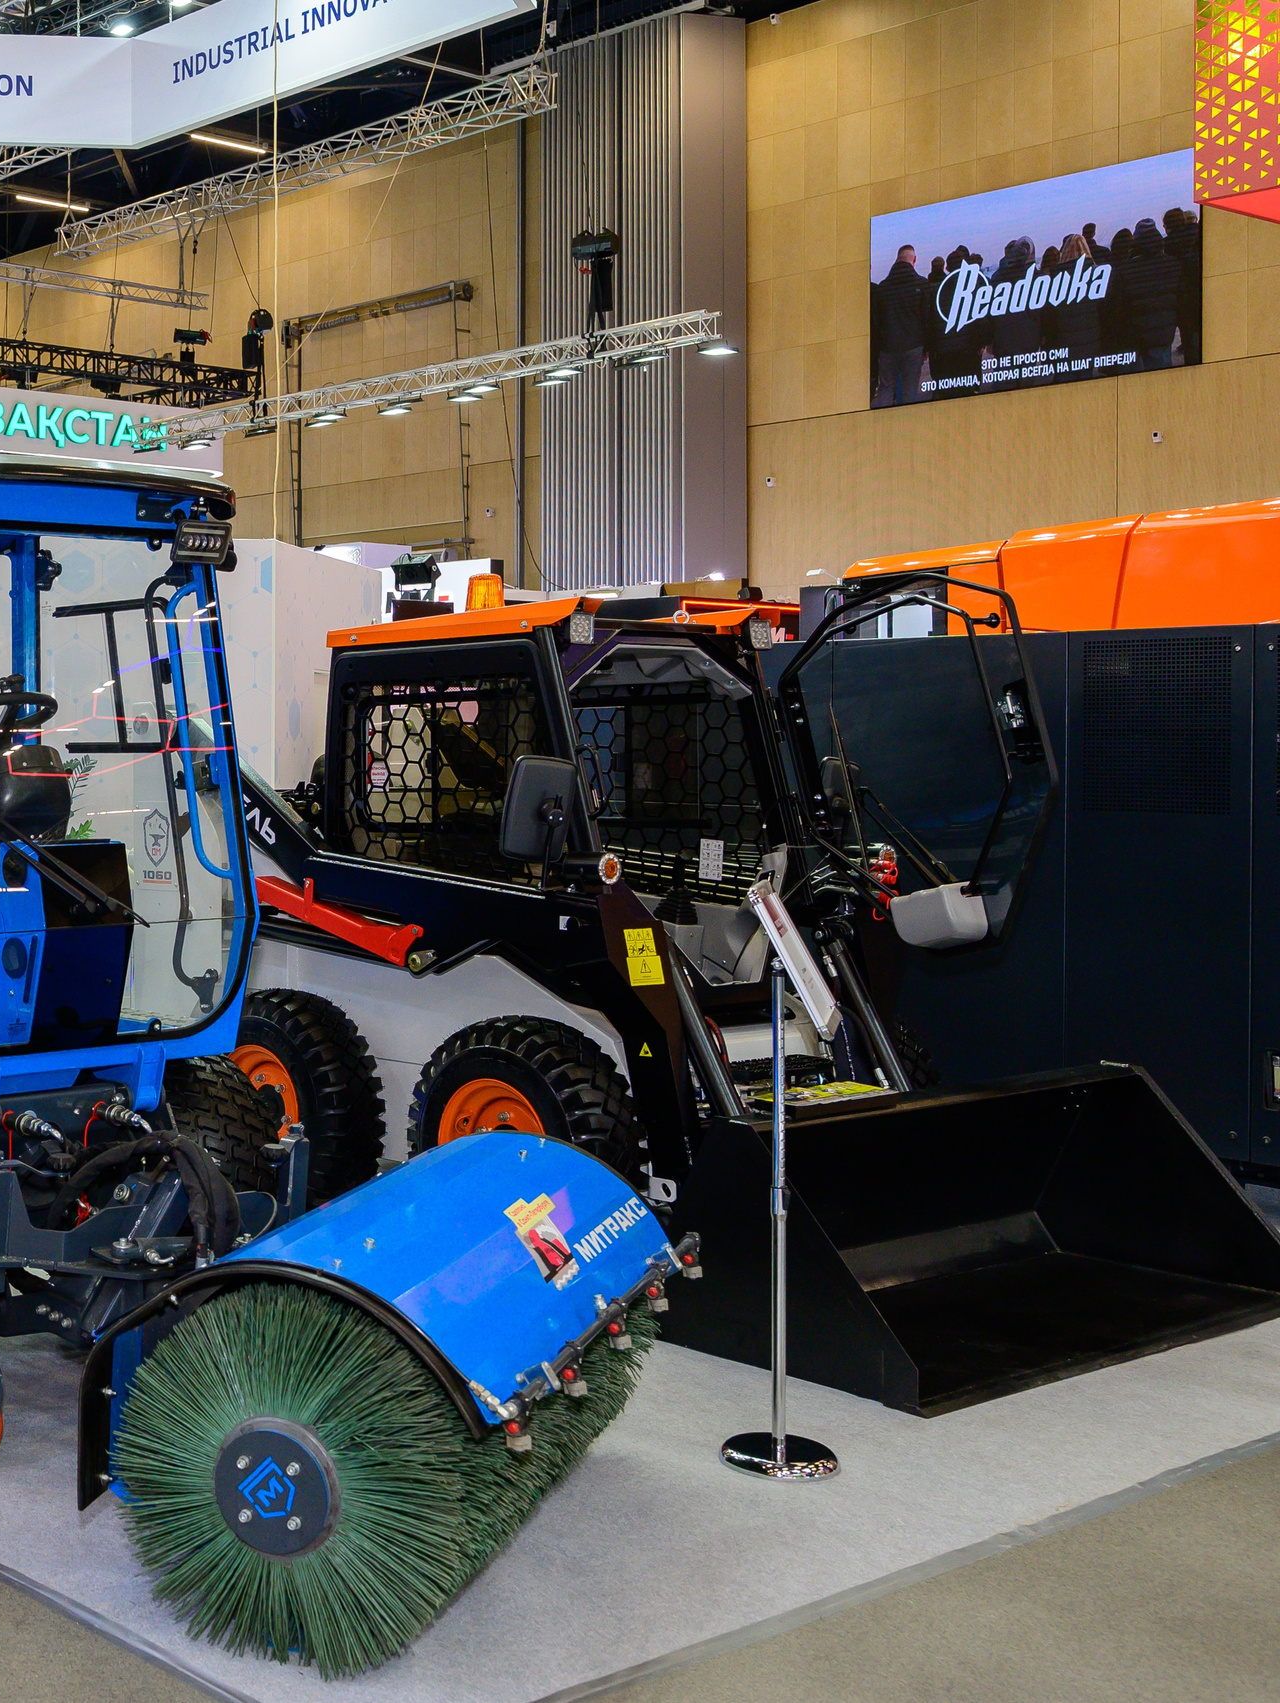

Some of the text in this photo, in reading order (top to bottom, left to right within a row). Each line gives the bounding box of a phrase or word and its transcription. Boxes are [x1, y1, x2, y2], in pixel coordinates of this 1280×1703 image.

[172, 18, 296, 84] INDUSTRIAL
[921, 351, 1136, 392] ЭТО КОМАНДА, КОТОРАЯ ВСЕГДА НА ШАГ ВПЕРЕДИ
[981, 347, 1069, 370] ЭТО НЕ ПРОСТО СМИ
[142, 869, 172, 880] 1060
[572, 1196, 648, 1264] МИТРАКС
